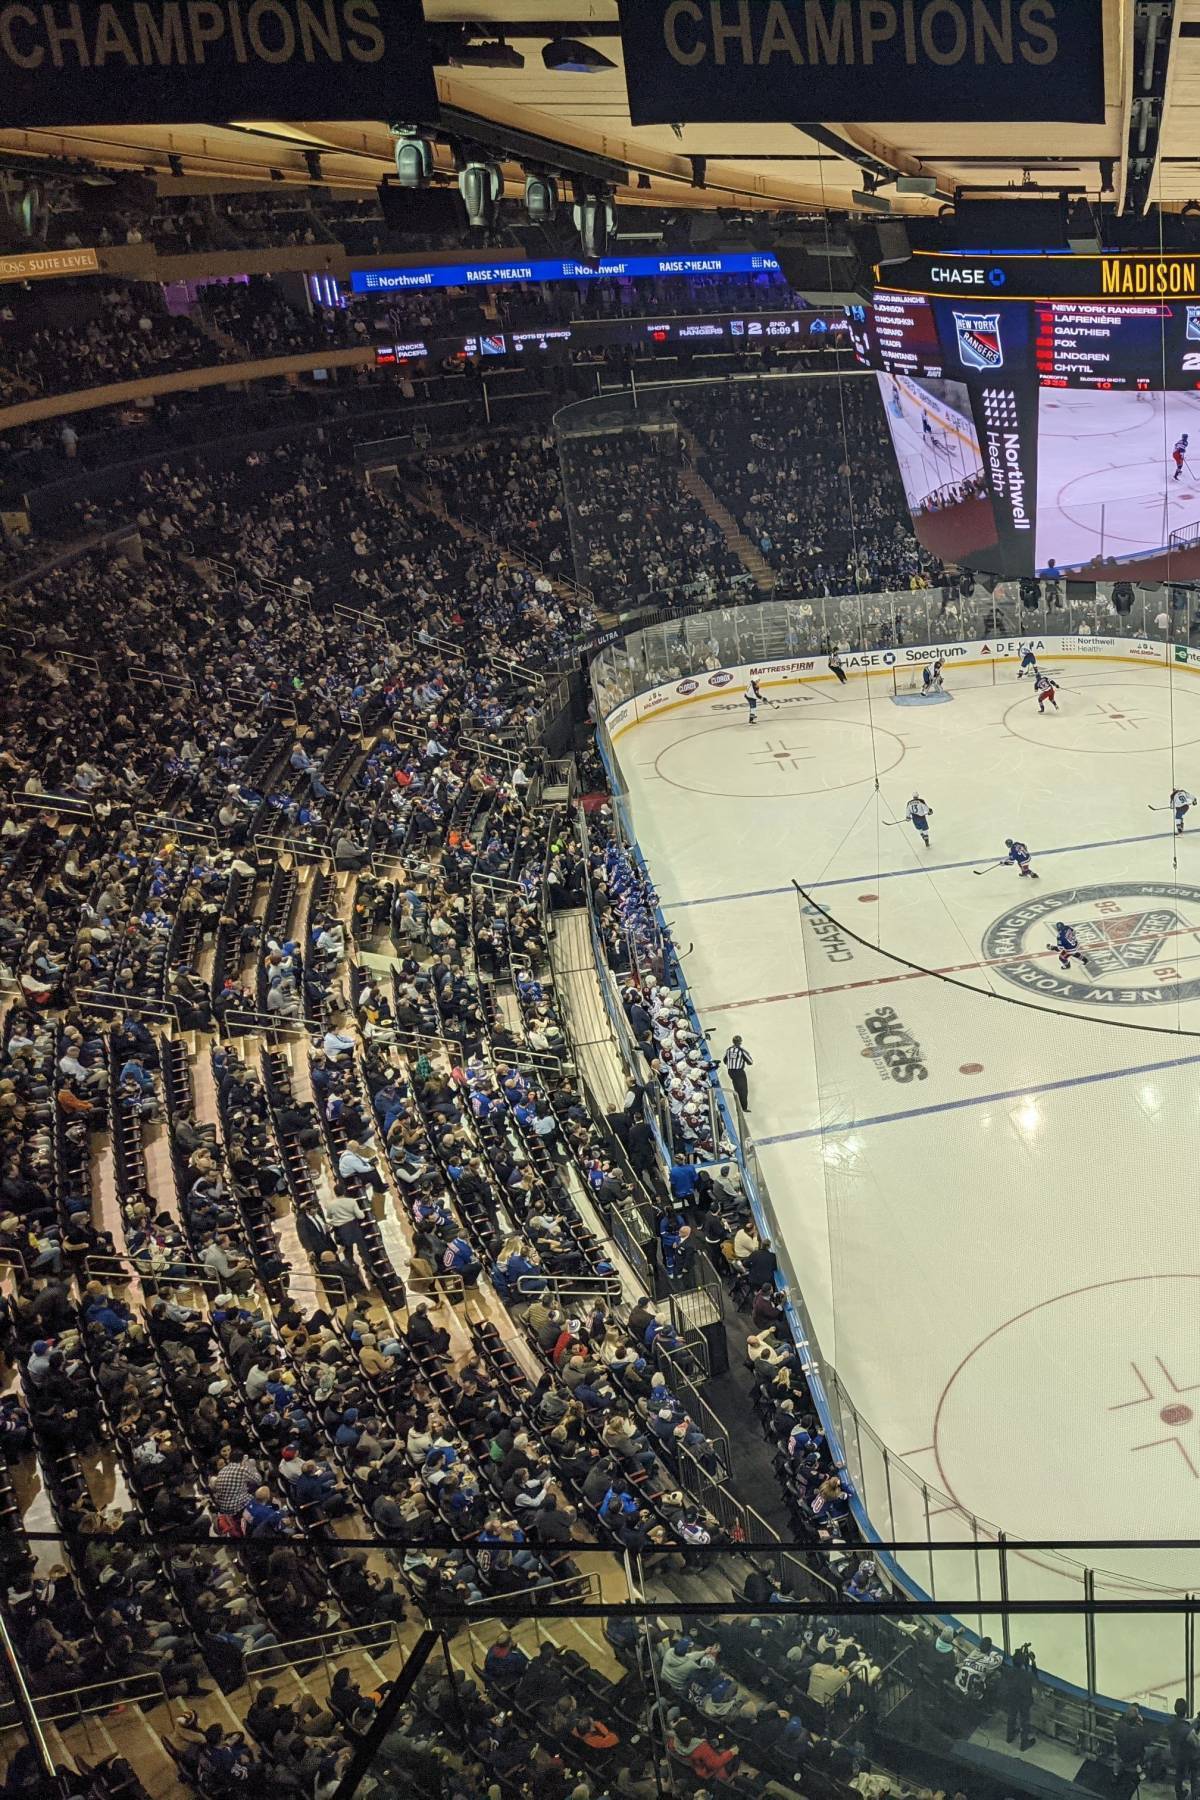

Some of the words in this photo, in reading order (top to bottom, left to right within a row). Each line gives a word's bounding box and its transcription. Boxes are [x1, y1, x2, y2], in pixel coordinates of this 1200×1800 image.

[2, 0, 385, 68] CHAMPIONS
[663, 0, 1059, 66] CHAMPIONS
[29, 258, 60, 271] SUITE
[62, 255, 94, 267] LEVEL
[659, 261, 684, 272] RAISE
[691, 259, 722, 271] HEALTH
[379, 273, 432, 287] Northwell
[466, 269, 493, 281] RAISE
[500, 267, 532, 280] HEALTH
[931, 267, 985, 284] CHASE
[1102, 259, 1196, 293] MADISON
[1052, 304, 1077, 312] NEW
[1078, 305, 1106, 313] YORK
[1107, 307, 1157, 315] RANGERS
[957, 318, 972, 329] NEW
[973, 320, 996, 331] YORK
[1054, 314, 1122, 325] LAFRENIÈRE
[679, 327, 724, 336] RANGERS
[748, 322, 763, 335] 2
[765, 326, 791, 336] 16:09
[791, 321, 800, 333] 1
[1054, 326, 1111, 337] GAUTHIER
[397, 343, 425, 352] KNICKS
[963, 331, 999, 363] RANGERS
[1054, 339, 1077, 348] FOX
[398, 349, 428, 358] PACERS
[1054, 351, 1110, 361] LINDGREN
[1054, 364, 1094, 373] CHYTIL
[987, 431, 1007, 496] Health
[1003, 433, 1031, 529] Northwell
[597, 630, 619, 645] ULTRA
[1077, 637, 1115, 646] Northwell
[1077, 645, 1103, 653] Health
[839, 654, 880, 668] HASE
[906, 646, 964, 662] Spectrum
[995, 898, 1063, 956] RANGERS
[810, 916, 854, 963] CHASE
[1006, 963, 1073, 996] YORK
[1084, 988, 1164, 1002] NEW
